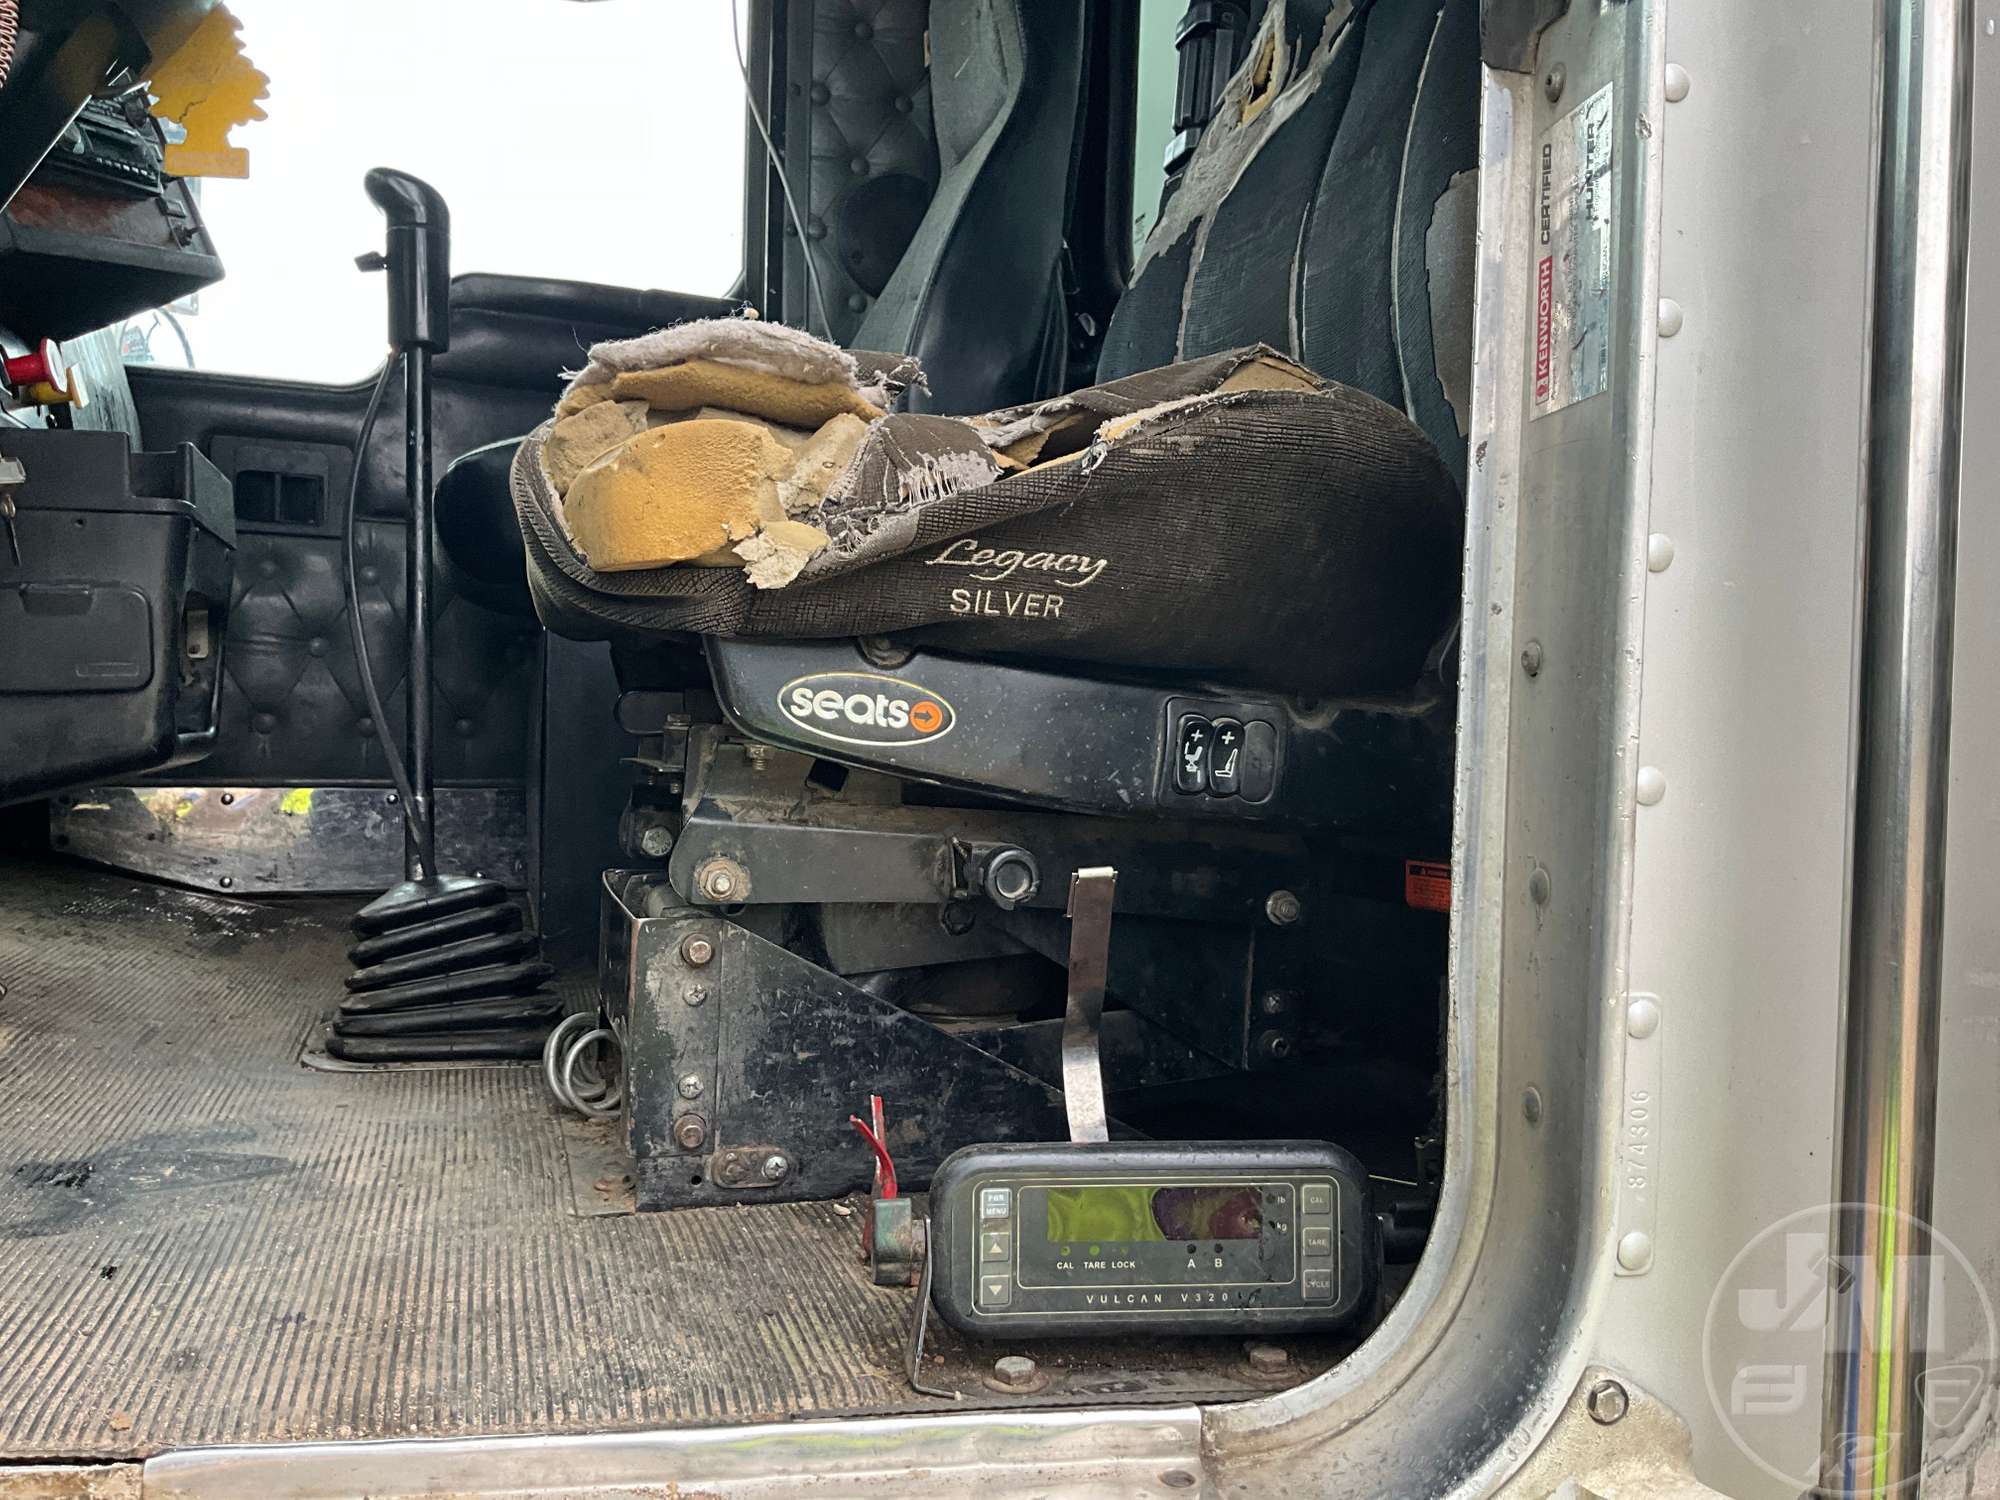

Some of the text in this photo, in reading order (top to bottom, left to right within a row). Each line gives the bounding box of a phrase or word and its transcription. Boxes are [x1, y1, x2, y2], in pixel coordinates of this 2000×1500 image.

[1586, 123, 1595, 221] HUNTER
[1538, 143, 1552, 376] KENWORTH CERTIFIED
[924, 538, 1108, 587] Legacy
[950, 588, 1064, 617] SILVER
[790, 687, 910, 729] seats
[1628, 1090, 1649, 1189] 874306
[1276, 1222, 1287, 1231] kg
[1056, 1261, 1136, 1269] CAL TARE LOCK
[1187, 1258, 1196, 1269] A
[1214, 1258, 1223, 1268] B
[1086, 1292, 1228, 1304] VULCAN V320
